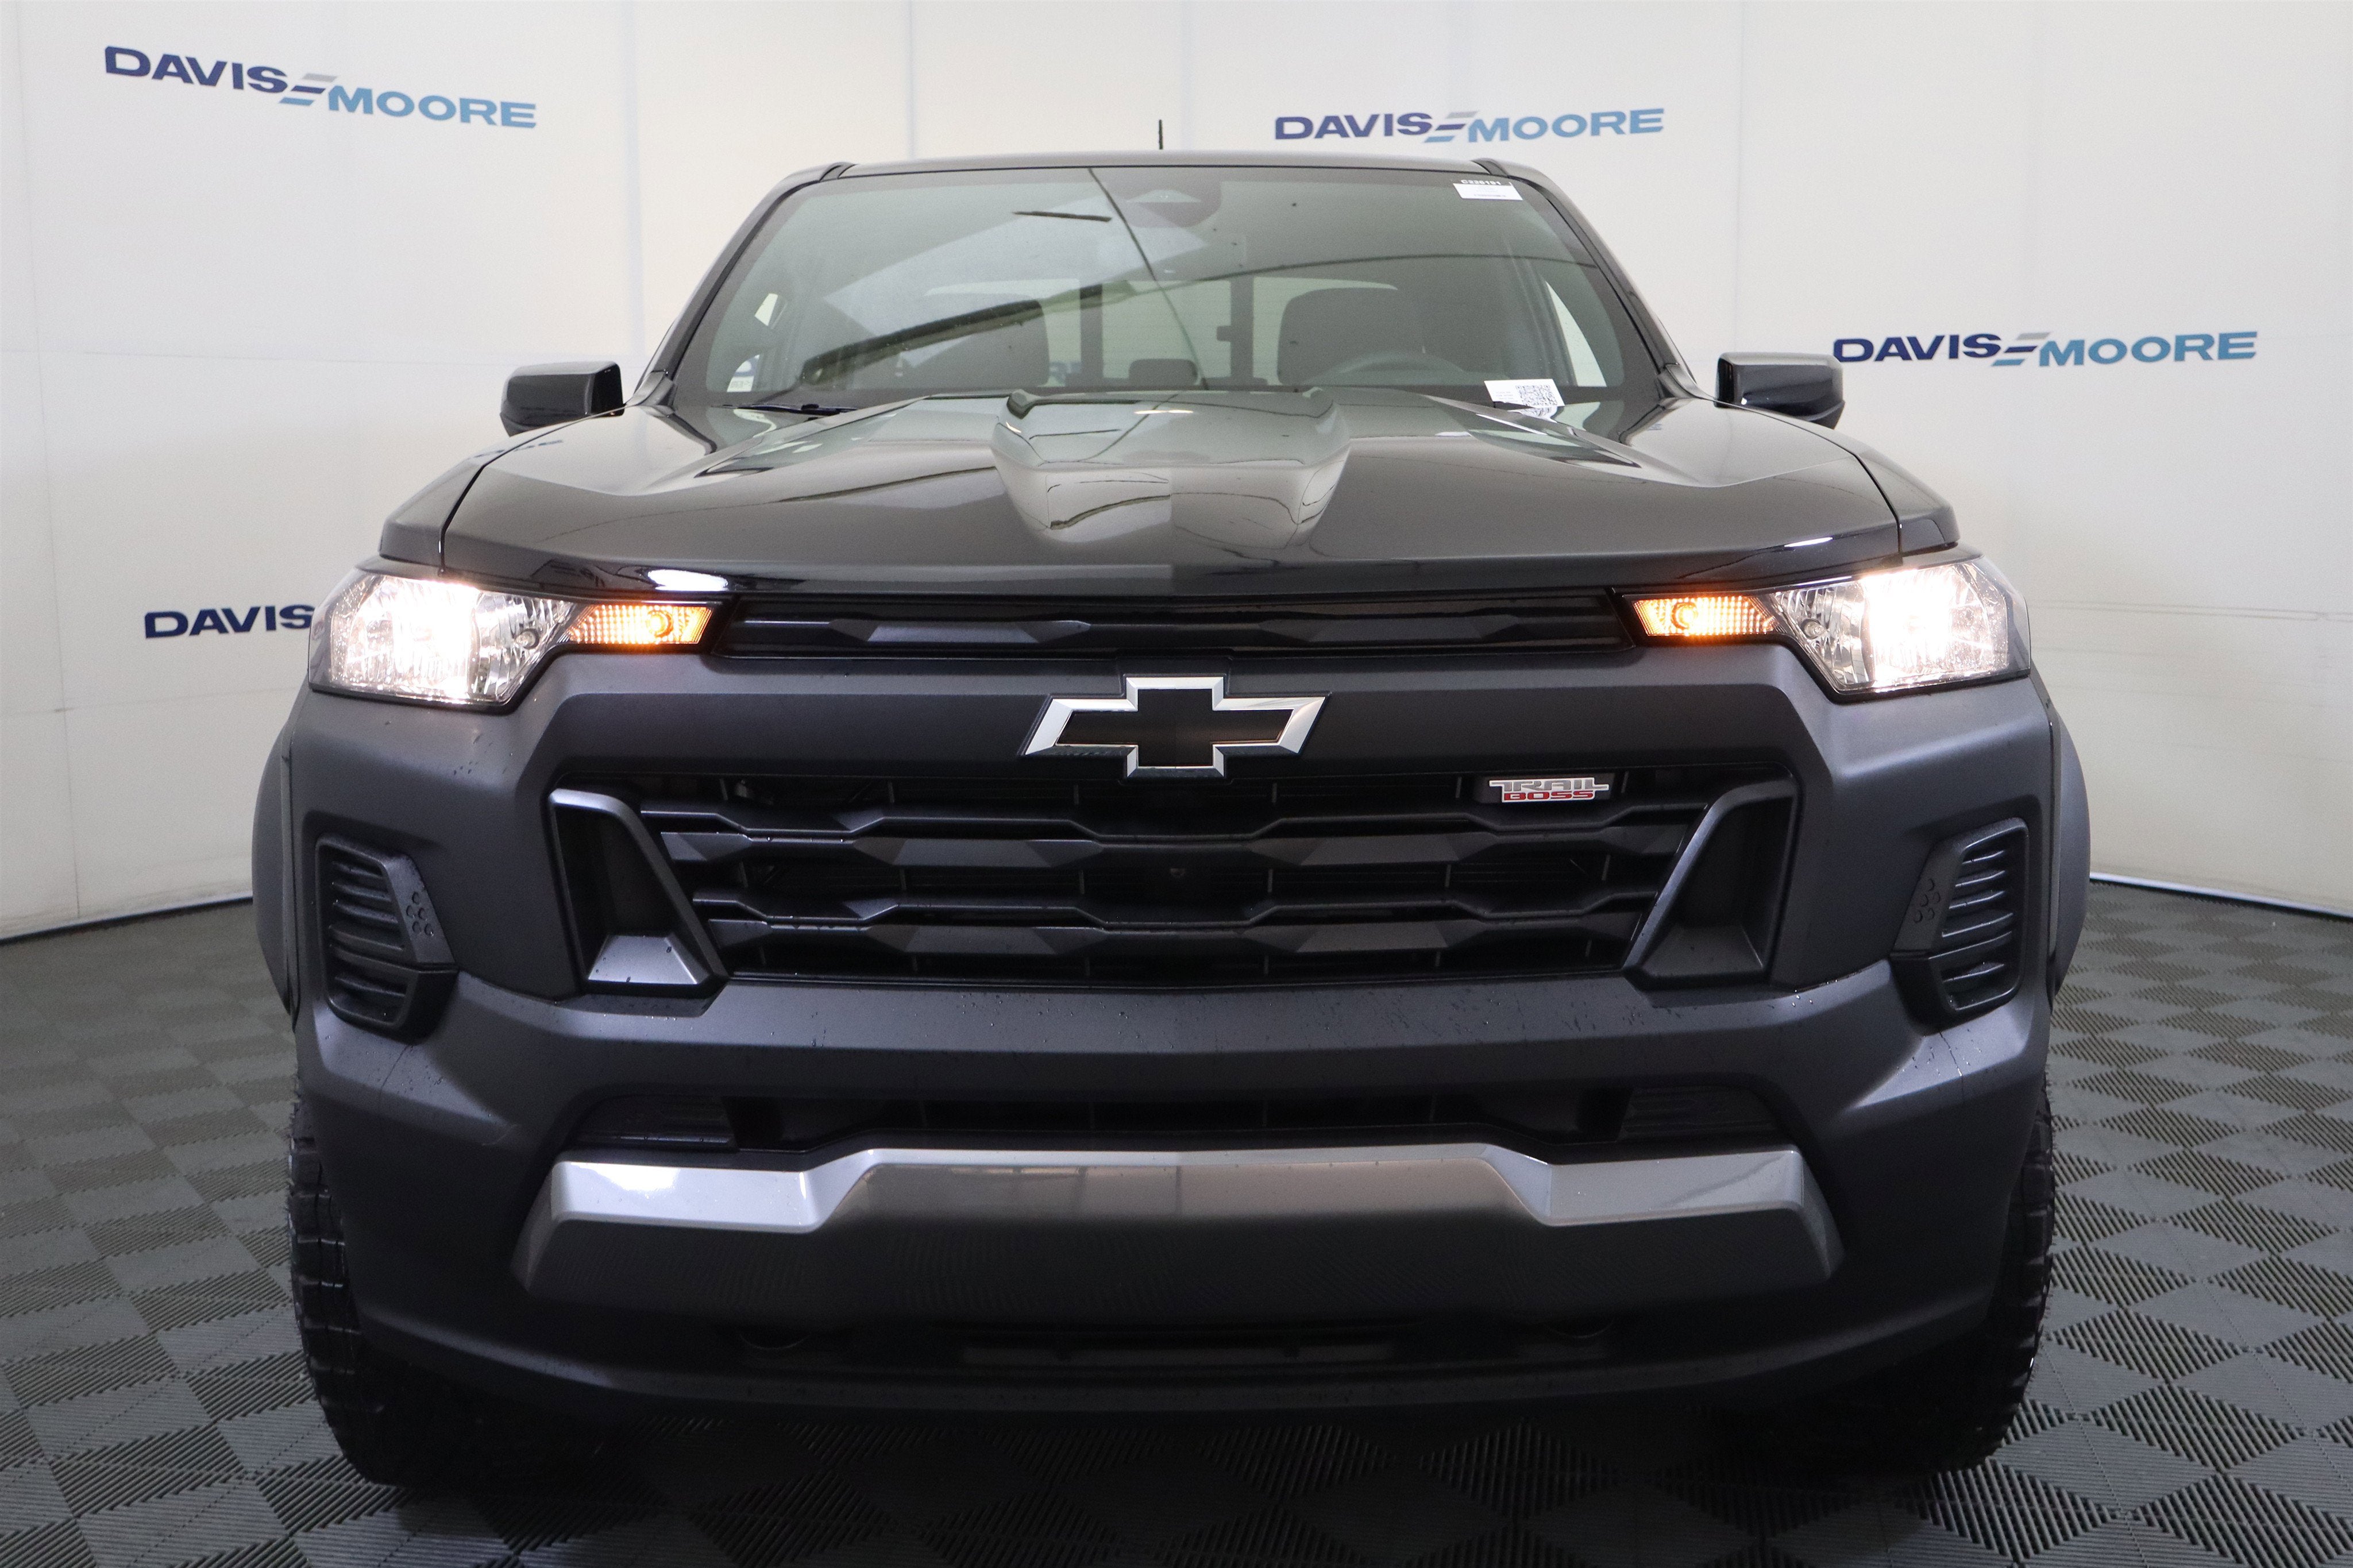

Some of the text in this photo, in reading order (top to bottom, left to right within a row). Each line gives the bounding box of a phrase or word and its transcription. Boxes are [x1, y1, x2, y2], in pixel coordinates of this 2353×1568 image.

[105, 45, 536, 128] DAVIS MOORE
[1275, 108, 1664, 142] DAVIS MOORE
[1833, 331, 2258, 366] DAVIS MOORE
[144, 604, 315, 638] DAVIS
[1490, 778, 1608, 792] TRAIL
[1503, 790, 1594, 801] BOSS
